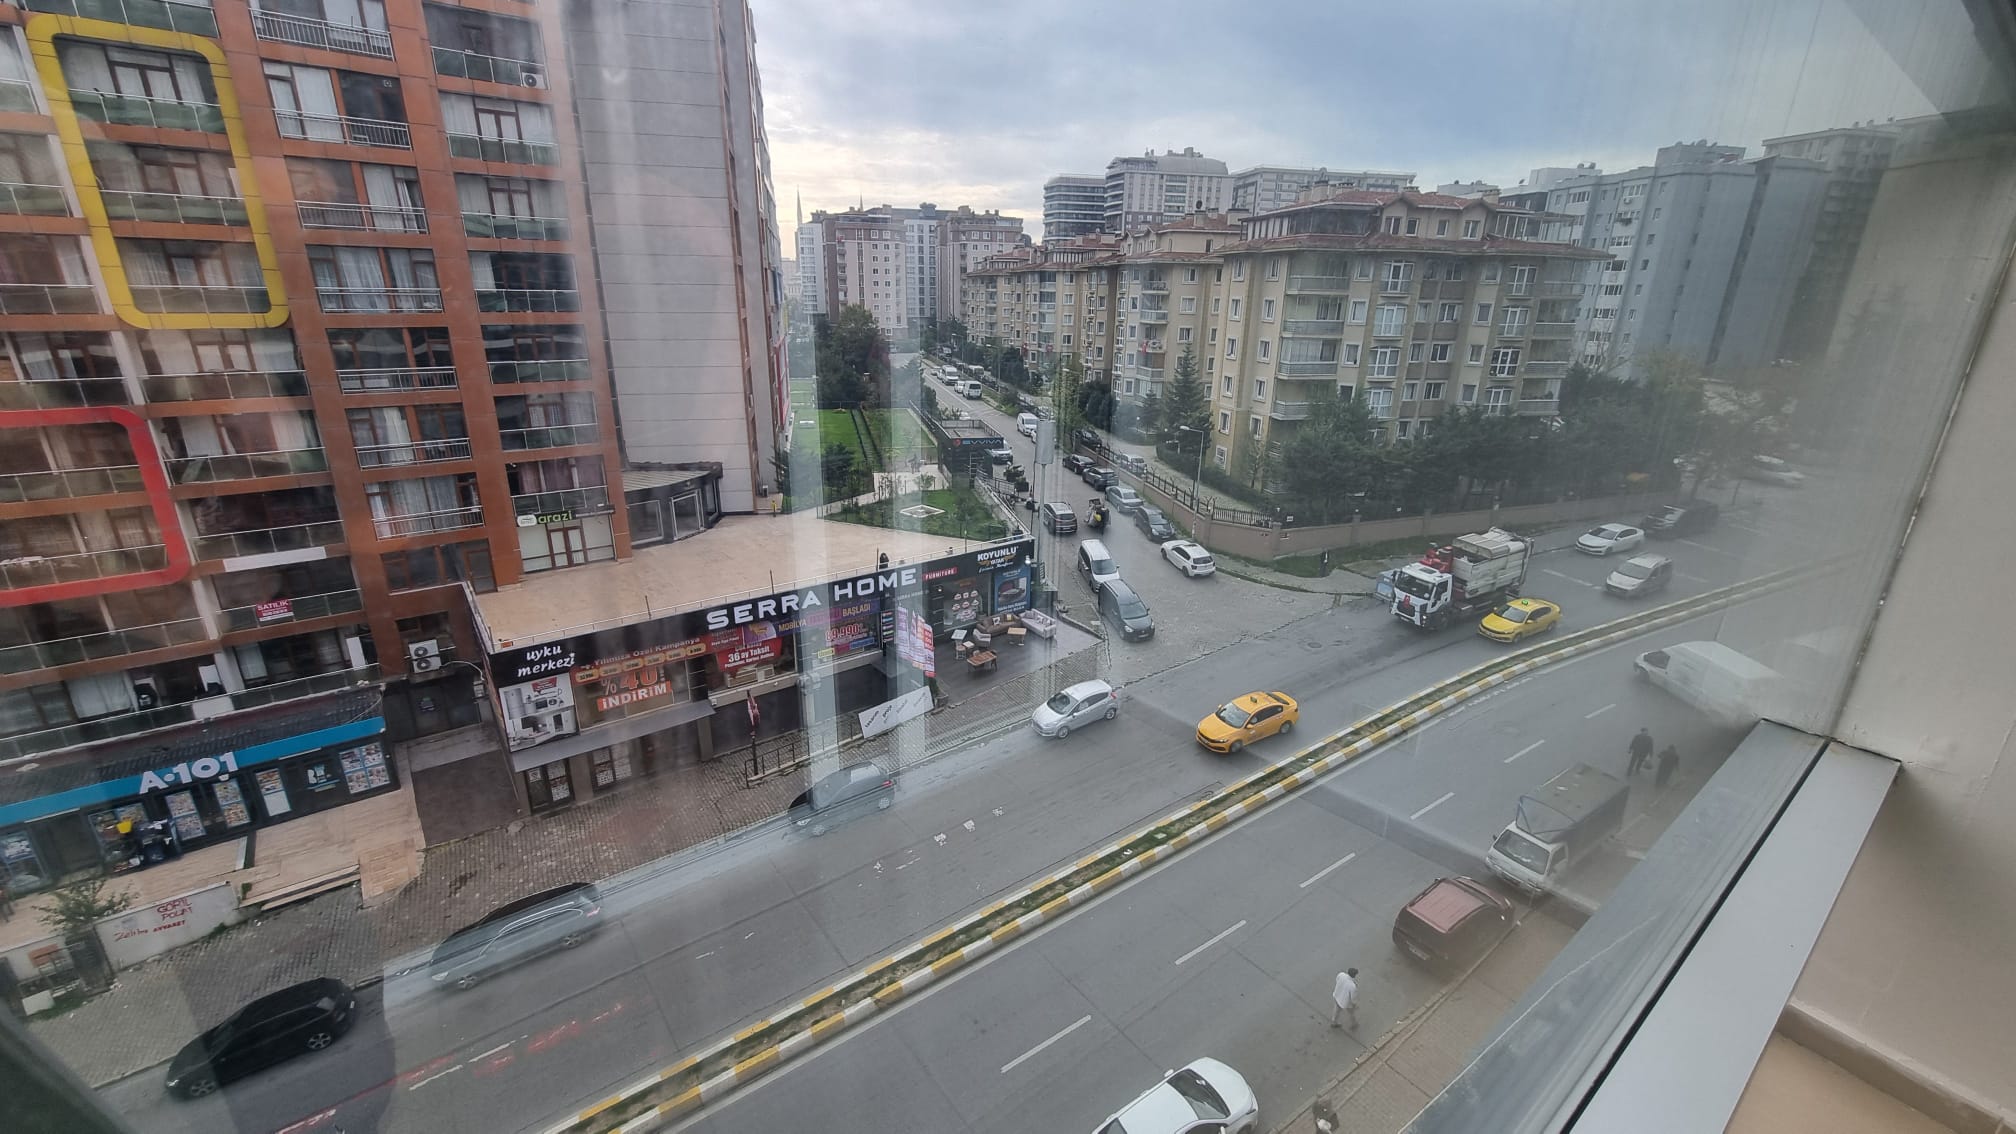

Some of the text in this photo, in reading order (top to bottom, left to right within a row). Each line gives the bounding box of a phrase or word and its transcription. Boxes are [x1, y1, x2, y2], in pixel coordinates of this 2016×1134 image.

[538, 510, 572, 524] arazi
[977, 546, 1017, 561] KOYUNLU
[258, 600, 289, 610] SATILIK
[706, 590, 821, 630] SERRA
[833, 568, 917, 601] HOME
[842, 603, 871, 618] BAŞLADI
[526, 645, 562, 662] uyku
[728, 652, 740, 662] 36
[741, 651, 749, 659] ay
[750, 646, 770, 656] Taksit
[517, 653, 575, 678] merkezi
